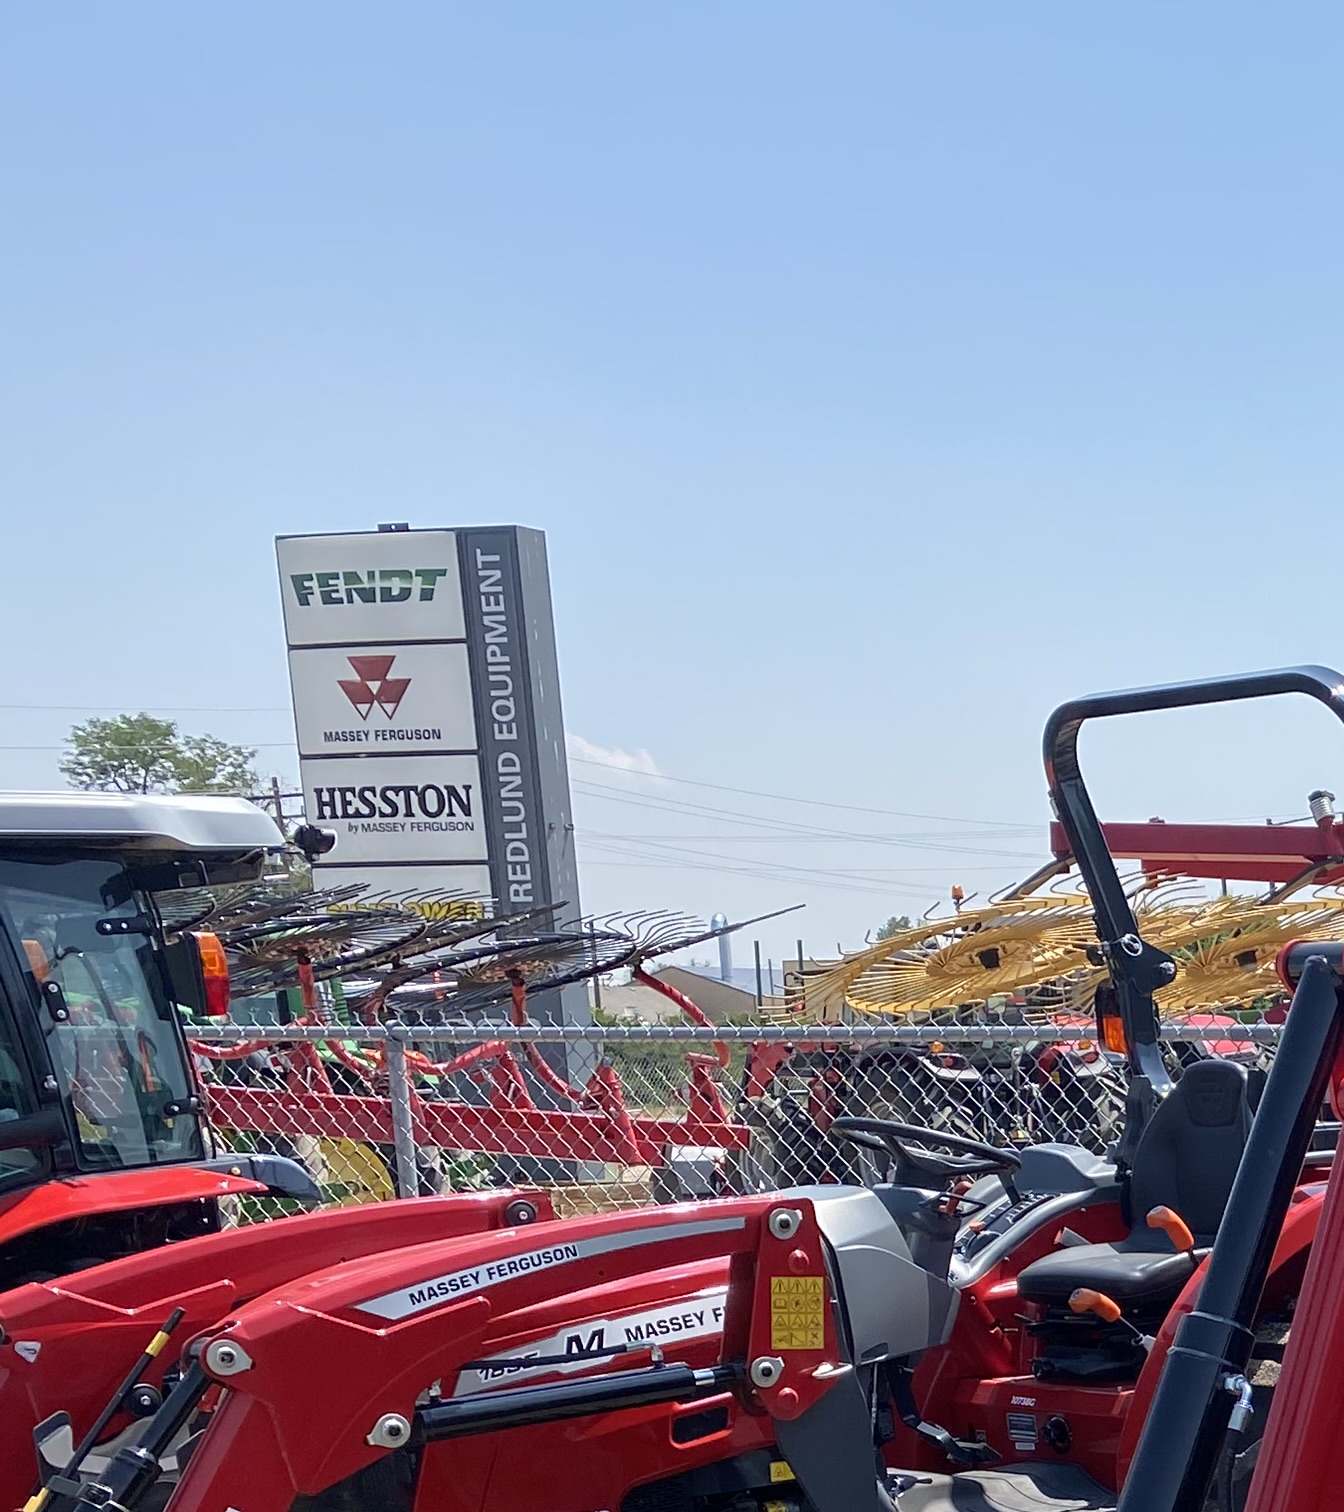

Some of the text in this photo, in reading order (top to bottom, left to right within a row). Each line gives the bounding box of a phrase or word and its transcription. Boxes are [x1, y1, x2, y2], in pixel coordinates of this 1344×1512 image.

[290, 568, 448, 607] FENDT
[323, 728, 442, 743] MASSEY FERGUSON
[475, 547, 534, 903] REDLUND EQUIPMENT
[313, 783, 473, 821] HESSTON
[348, 821, 475, 834] by MASSEY FERGUSON
[408, 1243, 580, 1306] MASSEY FERGUSON
[624, 1308, 706, 1343] MASSEY
